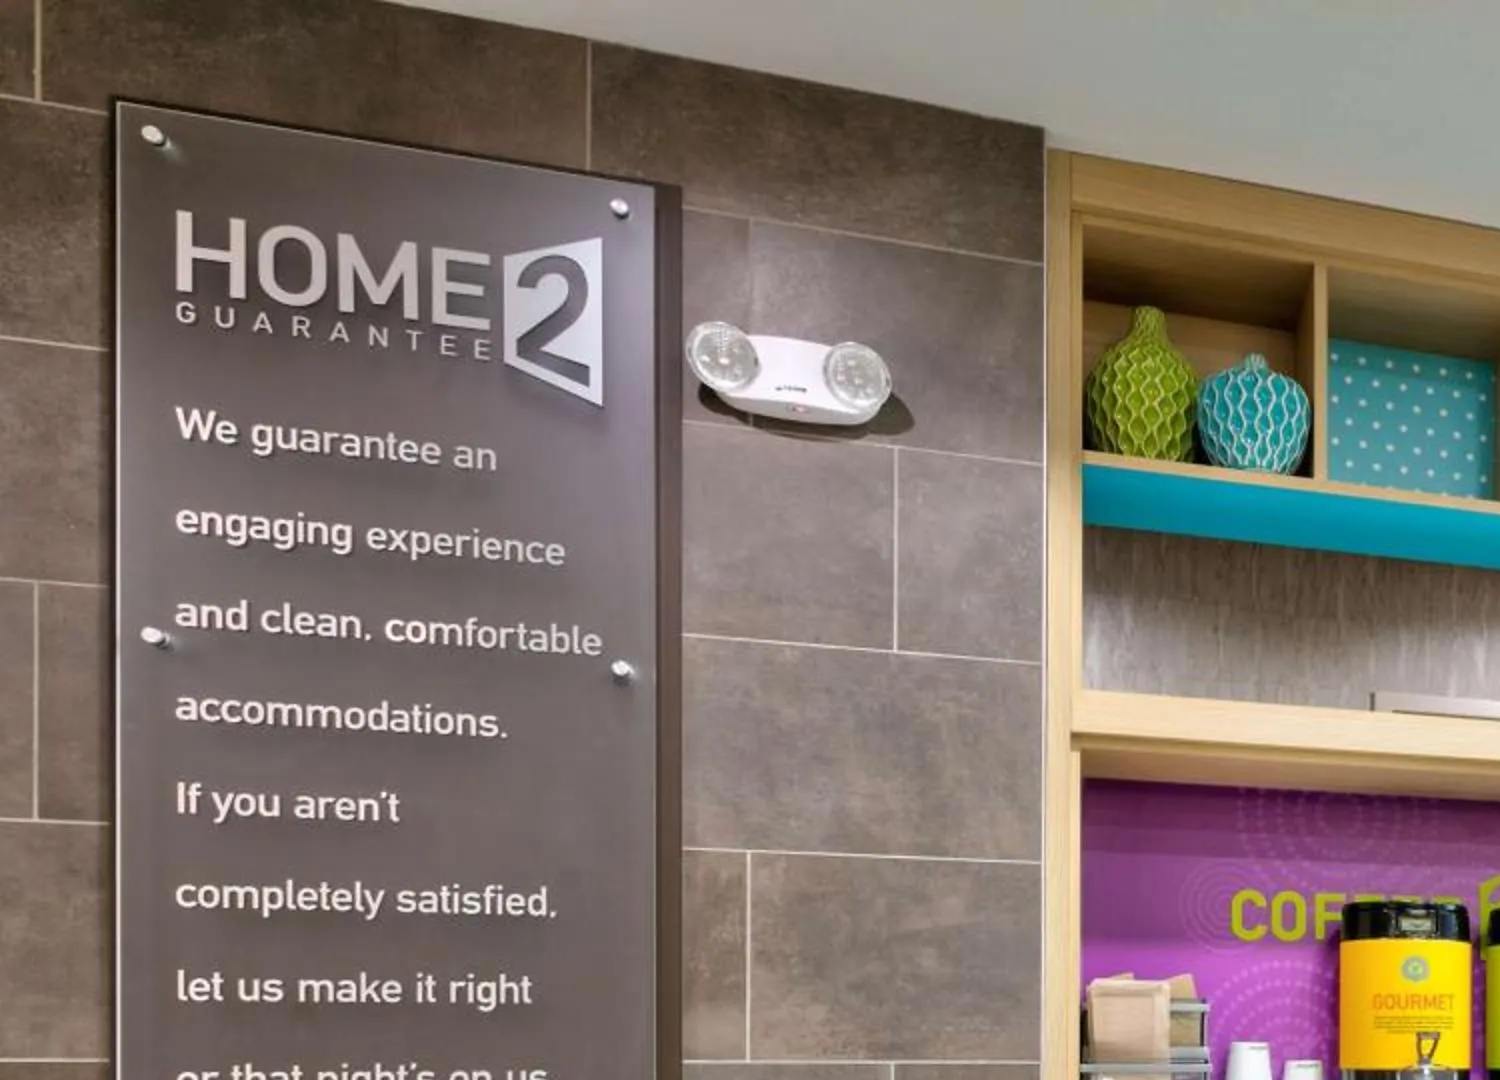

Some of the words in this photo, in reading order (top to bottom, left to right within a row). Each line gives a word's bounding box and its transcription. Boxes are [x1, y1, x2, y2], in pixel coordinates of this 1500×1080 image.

[175, 301, 491, 361] GUARANTEE
[175, 406, 238, 444] We
[251, 424, 442, 465] guarantee
[453, 446, 497, 471] an
[175, 509, 353, 555] engaging
[366, 528, 566, 566] experience
[175, 600, 248, 632] and
[384, 614, 602, 656] comfortable
[175, 695, 508, 739] accommodations.
[176, 782, 202, 815] If
[212, 792, 280, 824] you
[293, 789, 400, 822] aren't
[175, 879, 385, 920] completely
[176, 969, 224, 1002] let
[237, 977, 284, 1003] us
[298, 971, 403, 1004] make
[415, 971, 437, 1004] it
[449, 972, 532, 1012] right
[1372, 992, 1455, 1011] GOURMET
